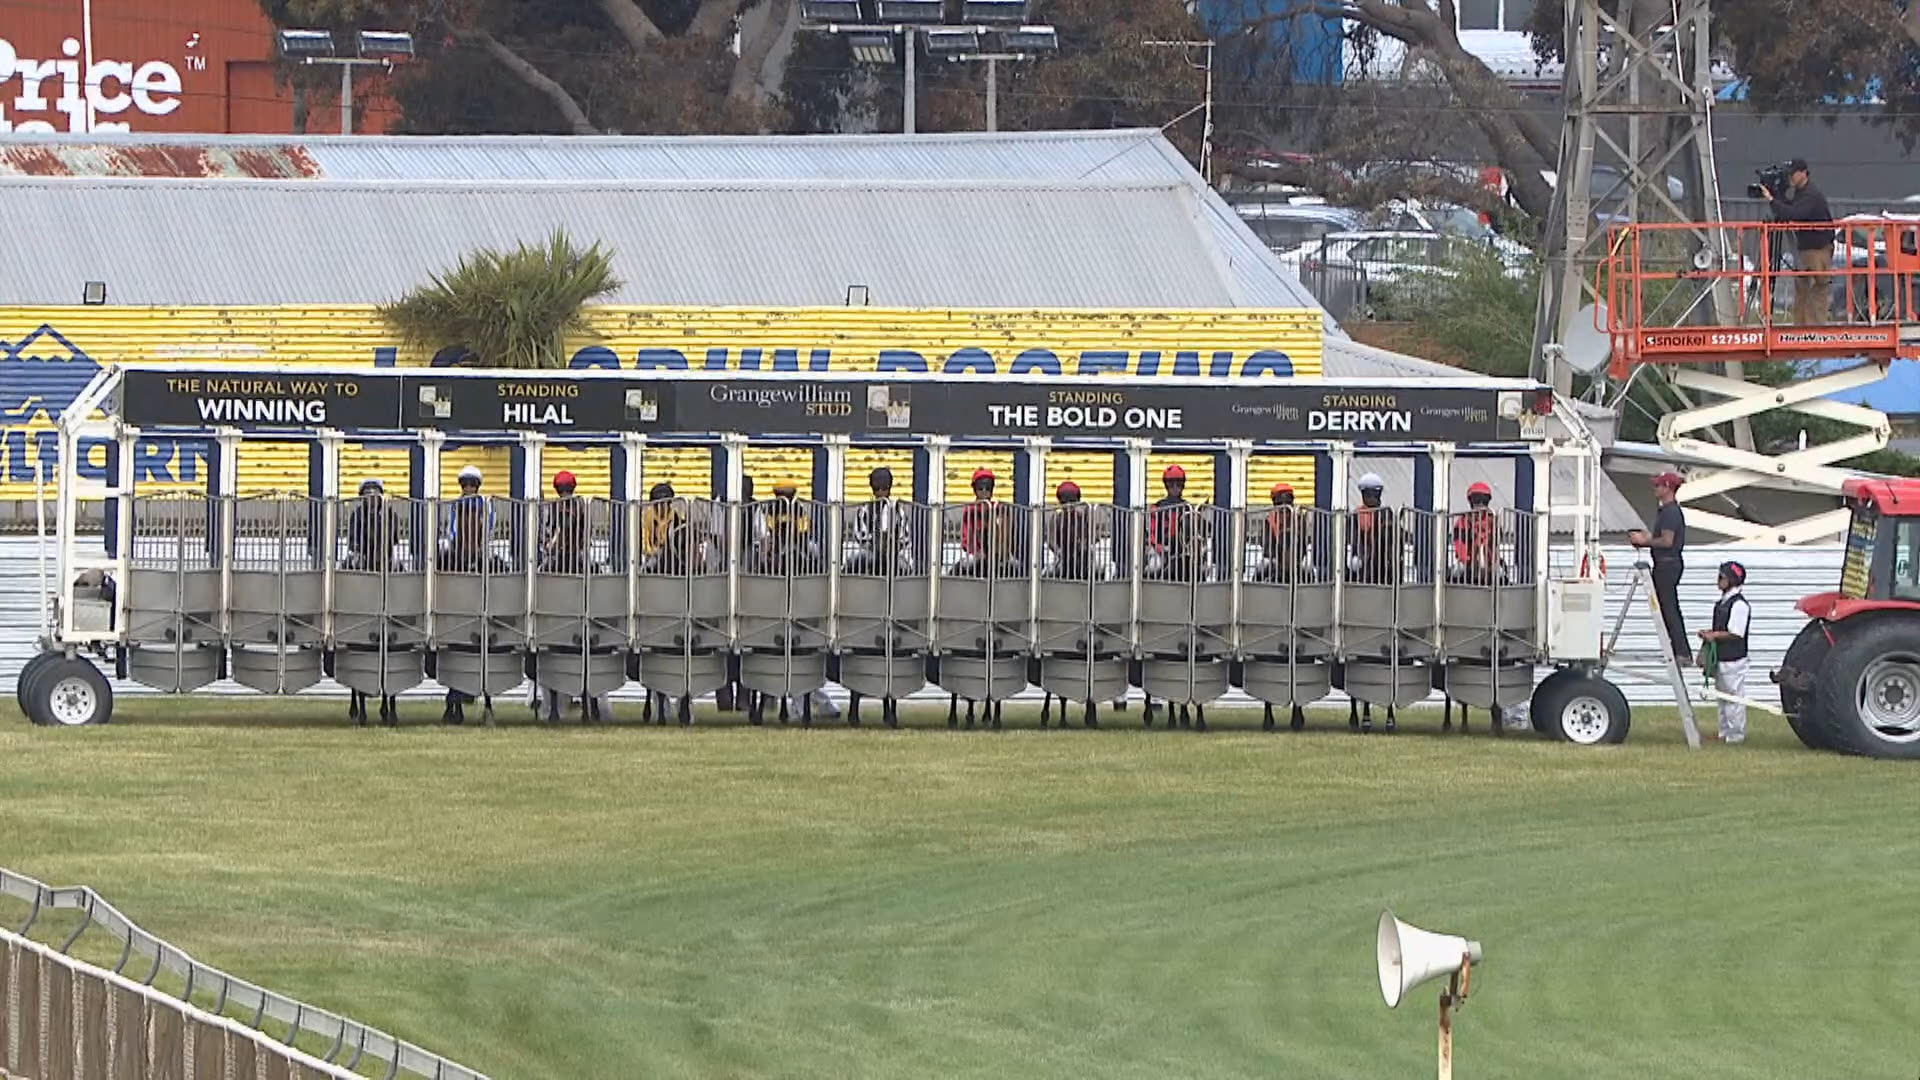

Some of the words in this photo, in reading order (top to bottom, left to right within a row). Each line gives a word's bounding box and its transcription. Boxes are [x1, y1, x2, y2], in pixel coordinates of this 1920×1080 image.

[0, 37, 182, 115] rice
[1657, 334, 1706, 346] snorkel
[167, 379, 200, 393] THE
[206, 379, 285, 395] NATURAL
[290, 382, 328, 395] WAY
[334, 382, 358, 396] TO
[497, 383, 579, 398] STANDING
[710, 384, 851, 408] Grangewilliam
[1049, 391, 1123, 405] STANDING
[1323, 395, 1396, 408] STANDING
[197, 398, 326, 422] WINNING
[503, 403, 574, 425] HILAL
[804, 403, 851, 416] STUD
[988, 405, 1038, 426] THE
[1047, 407, 1117, 427] BOLD
[1124, 408, 1182, 429] ONE
[1307, 411, 1412, 432] DERRYN
